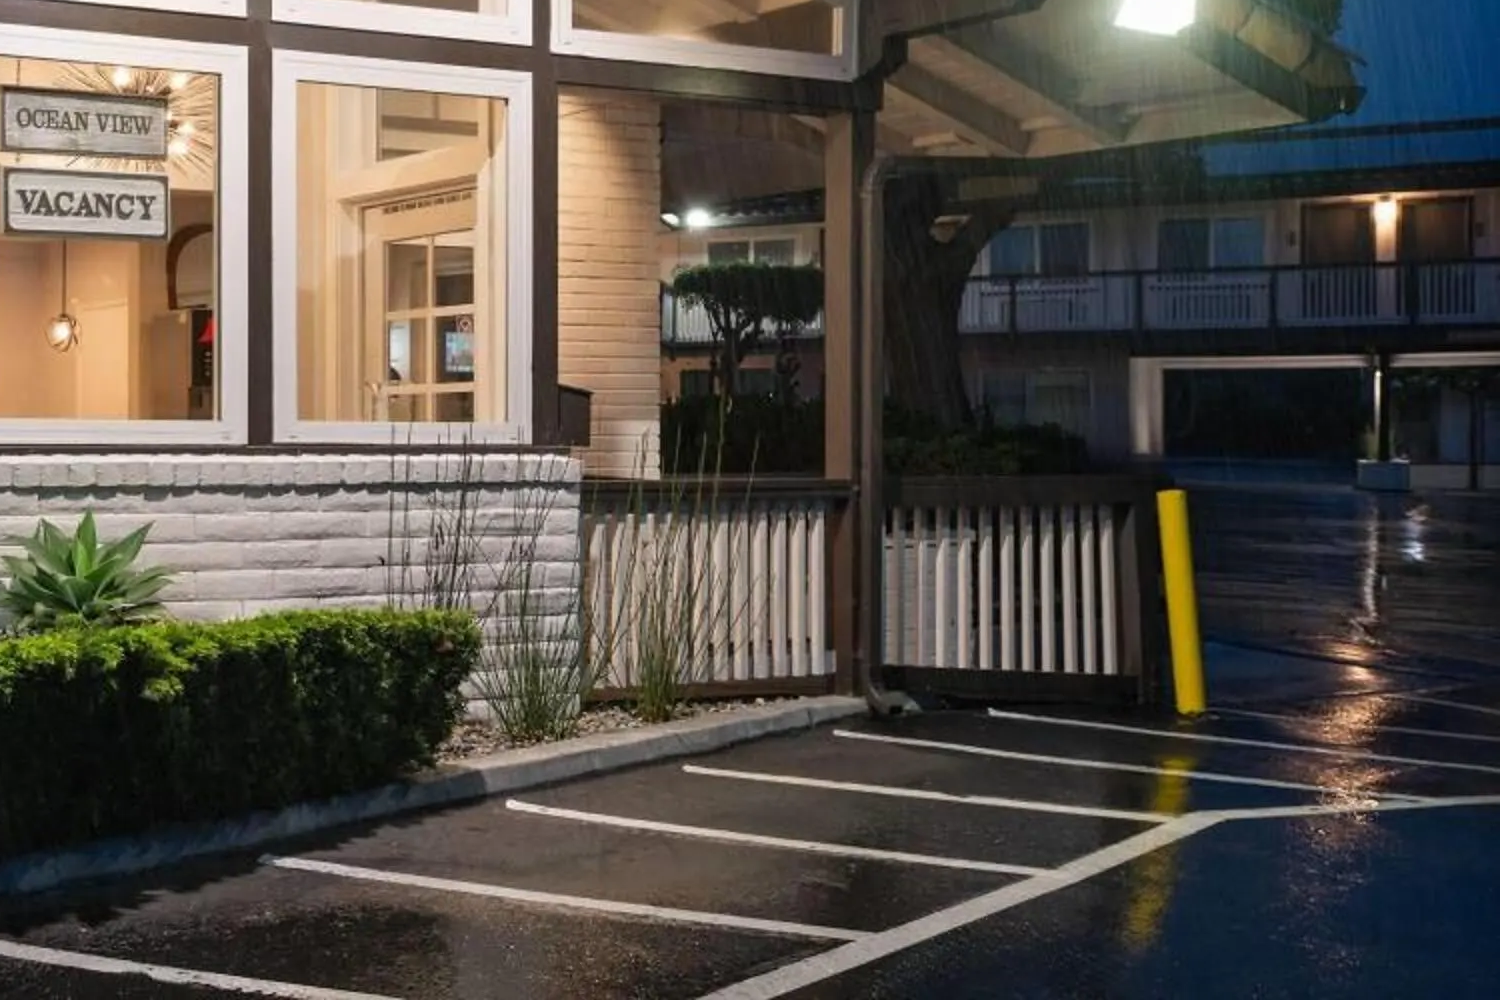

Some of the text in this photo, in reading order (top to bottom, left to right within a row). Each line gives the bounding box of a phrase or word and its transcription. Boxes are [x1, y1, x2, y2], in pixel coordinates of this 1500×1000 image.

[16, 108, 152, 135] OCEAN VIEW
[16, 189, 156, 220] VACANCY
